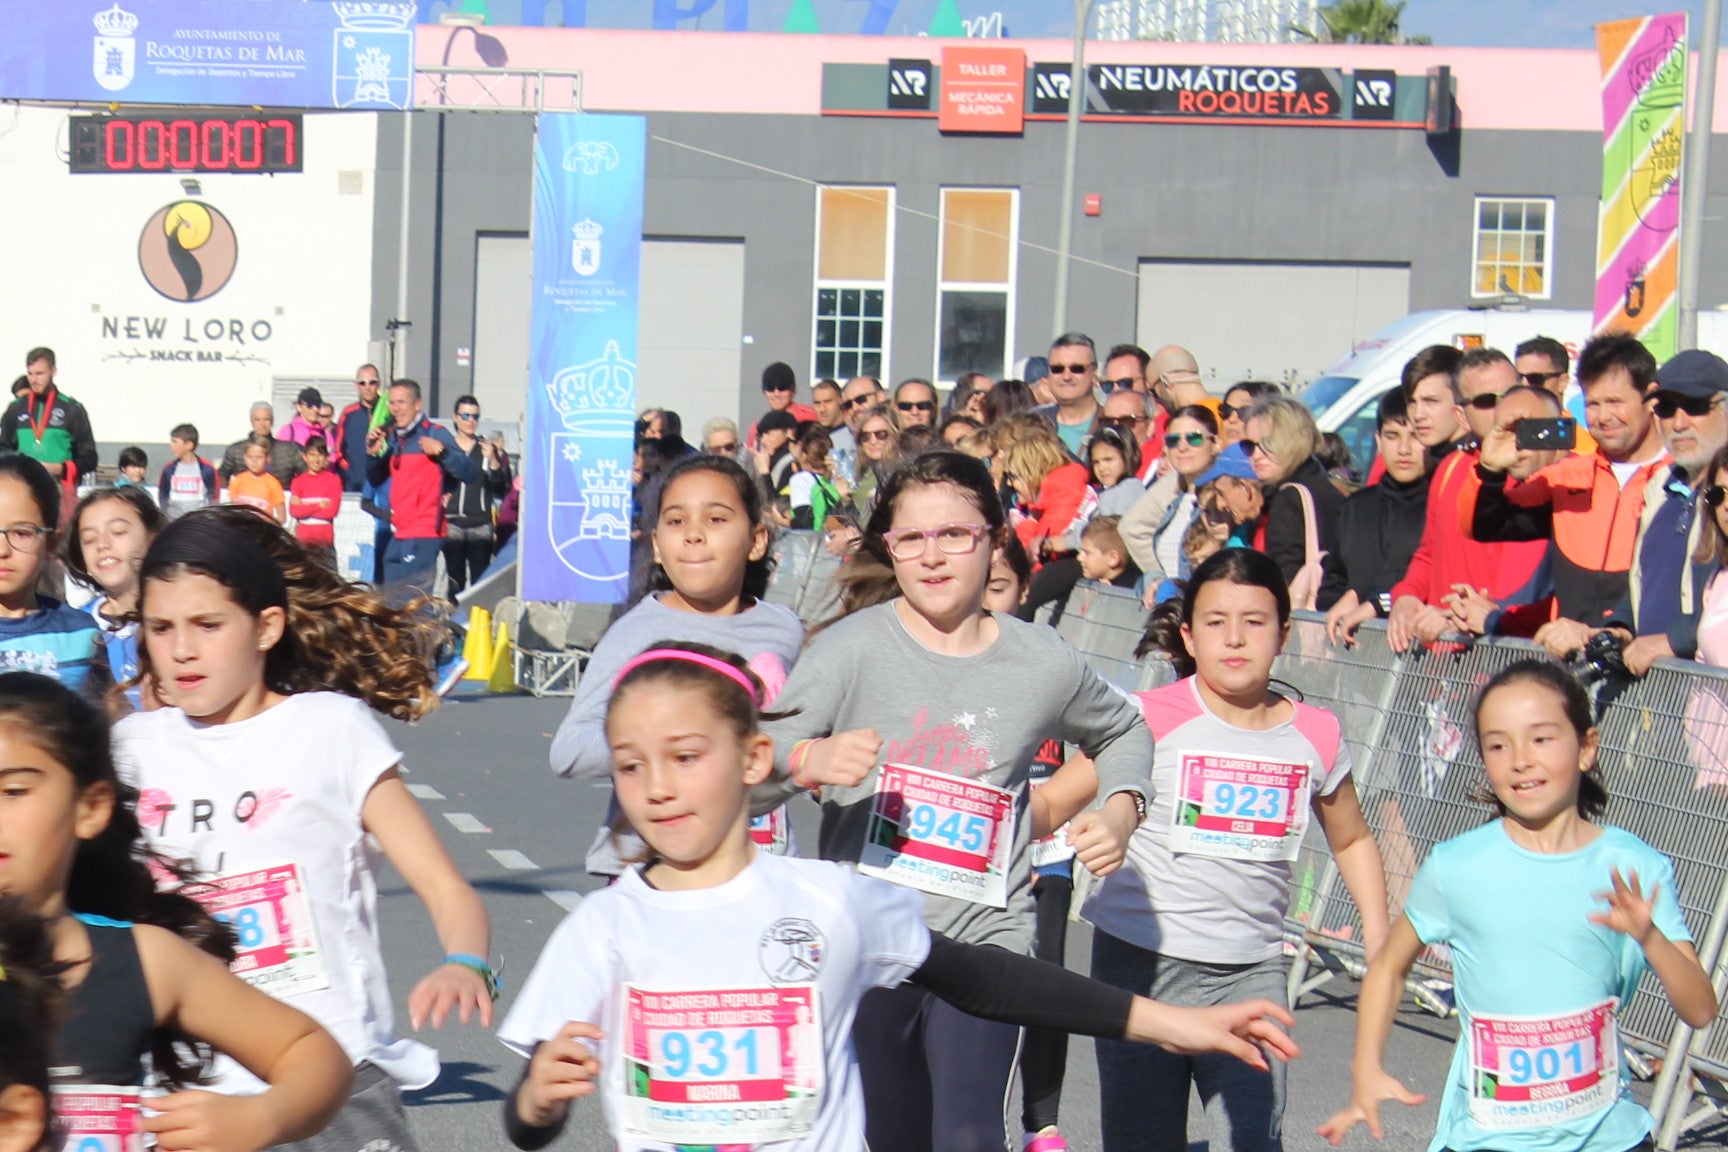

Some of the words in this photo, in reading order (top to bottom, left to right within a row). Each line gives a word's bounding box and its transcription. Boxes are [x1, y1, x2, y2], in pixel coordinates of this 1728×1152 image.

[176, 29, 263, 42] AYUNTAMIENTO
[266, 31, 280, 42] DE
[146, 41, 232, 62] ROQUETAS
[238, 47, 258, 60] DE
[266, 45, 306, 62] MAR
[959, 63, 1006, 76] TALLER
[1099, 66, 1297, 93] NEUMÁTICOS
[949, 90, 1014, 104] MECÁNICA
[1178, 90, 1329, 114] ROQUETAS
[102, 316, 167, 339] NEW
[183, 318, 272, 345] LORO
[150, 350, 192, 361] SNACK
[197, 351, 222, 362] BAR
[1220, 759, 1257, 772] CARRERA
[1258, 763, 1293, 775] POPULAR
[1214, 783, 1281, 819] 923
[909, 804, 987, 852] 945
[661, 994, 719, 1009] CARRERA
[720, 992, 779, 1007] POPULAR
[642, 1012, 686, 1027] CIUDAD
[689, 1011, 705, 1026] DE
[707, 1010, 774, 1025] ROQUETAS
[662, 1029, 758, 1078] 931
[1509, 1042, 1583, 1084] 901
